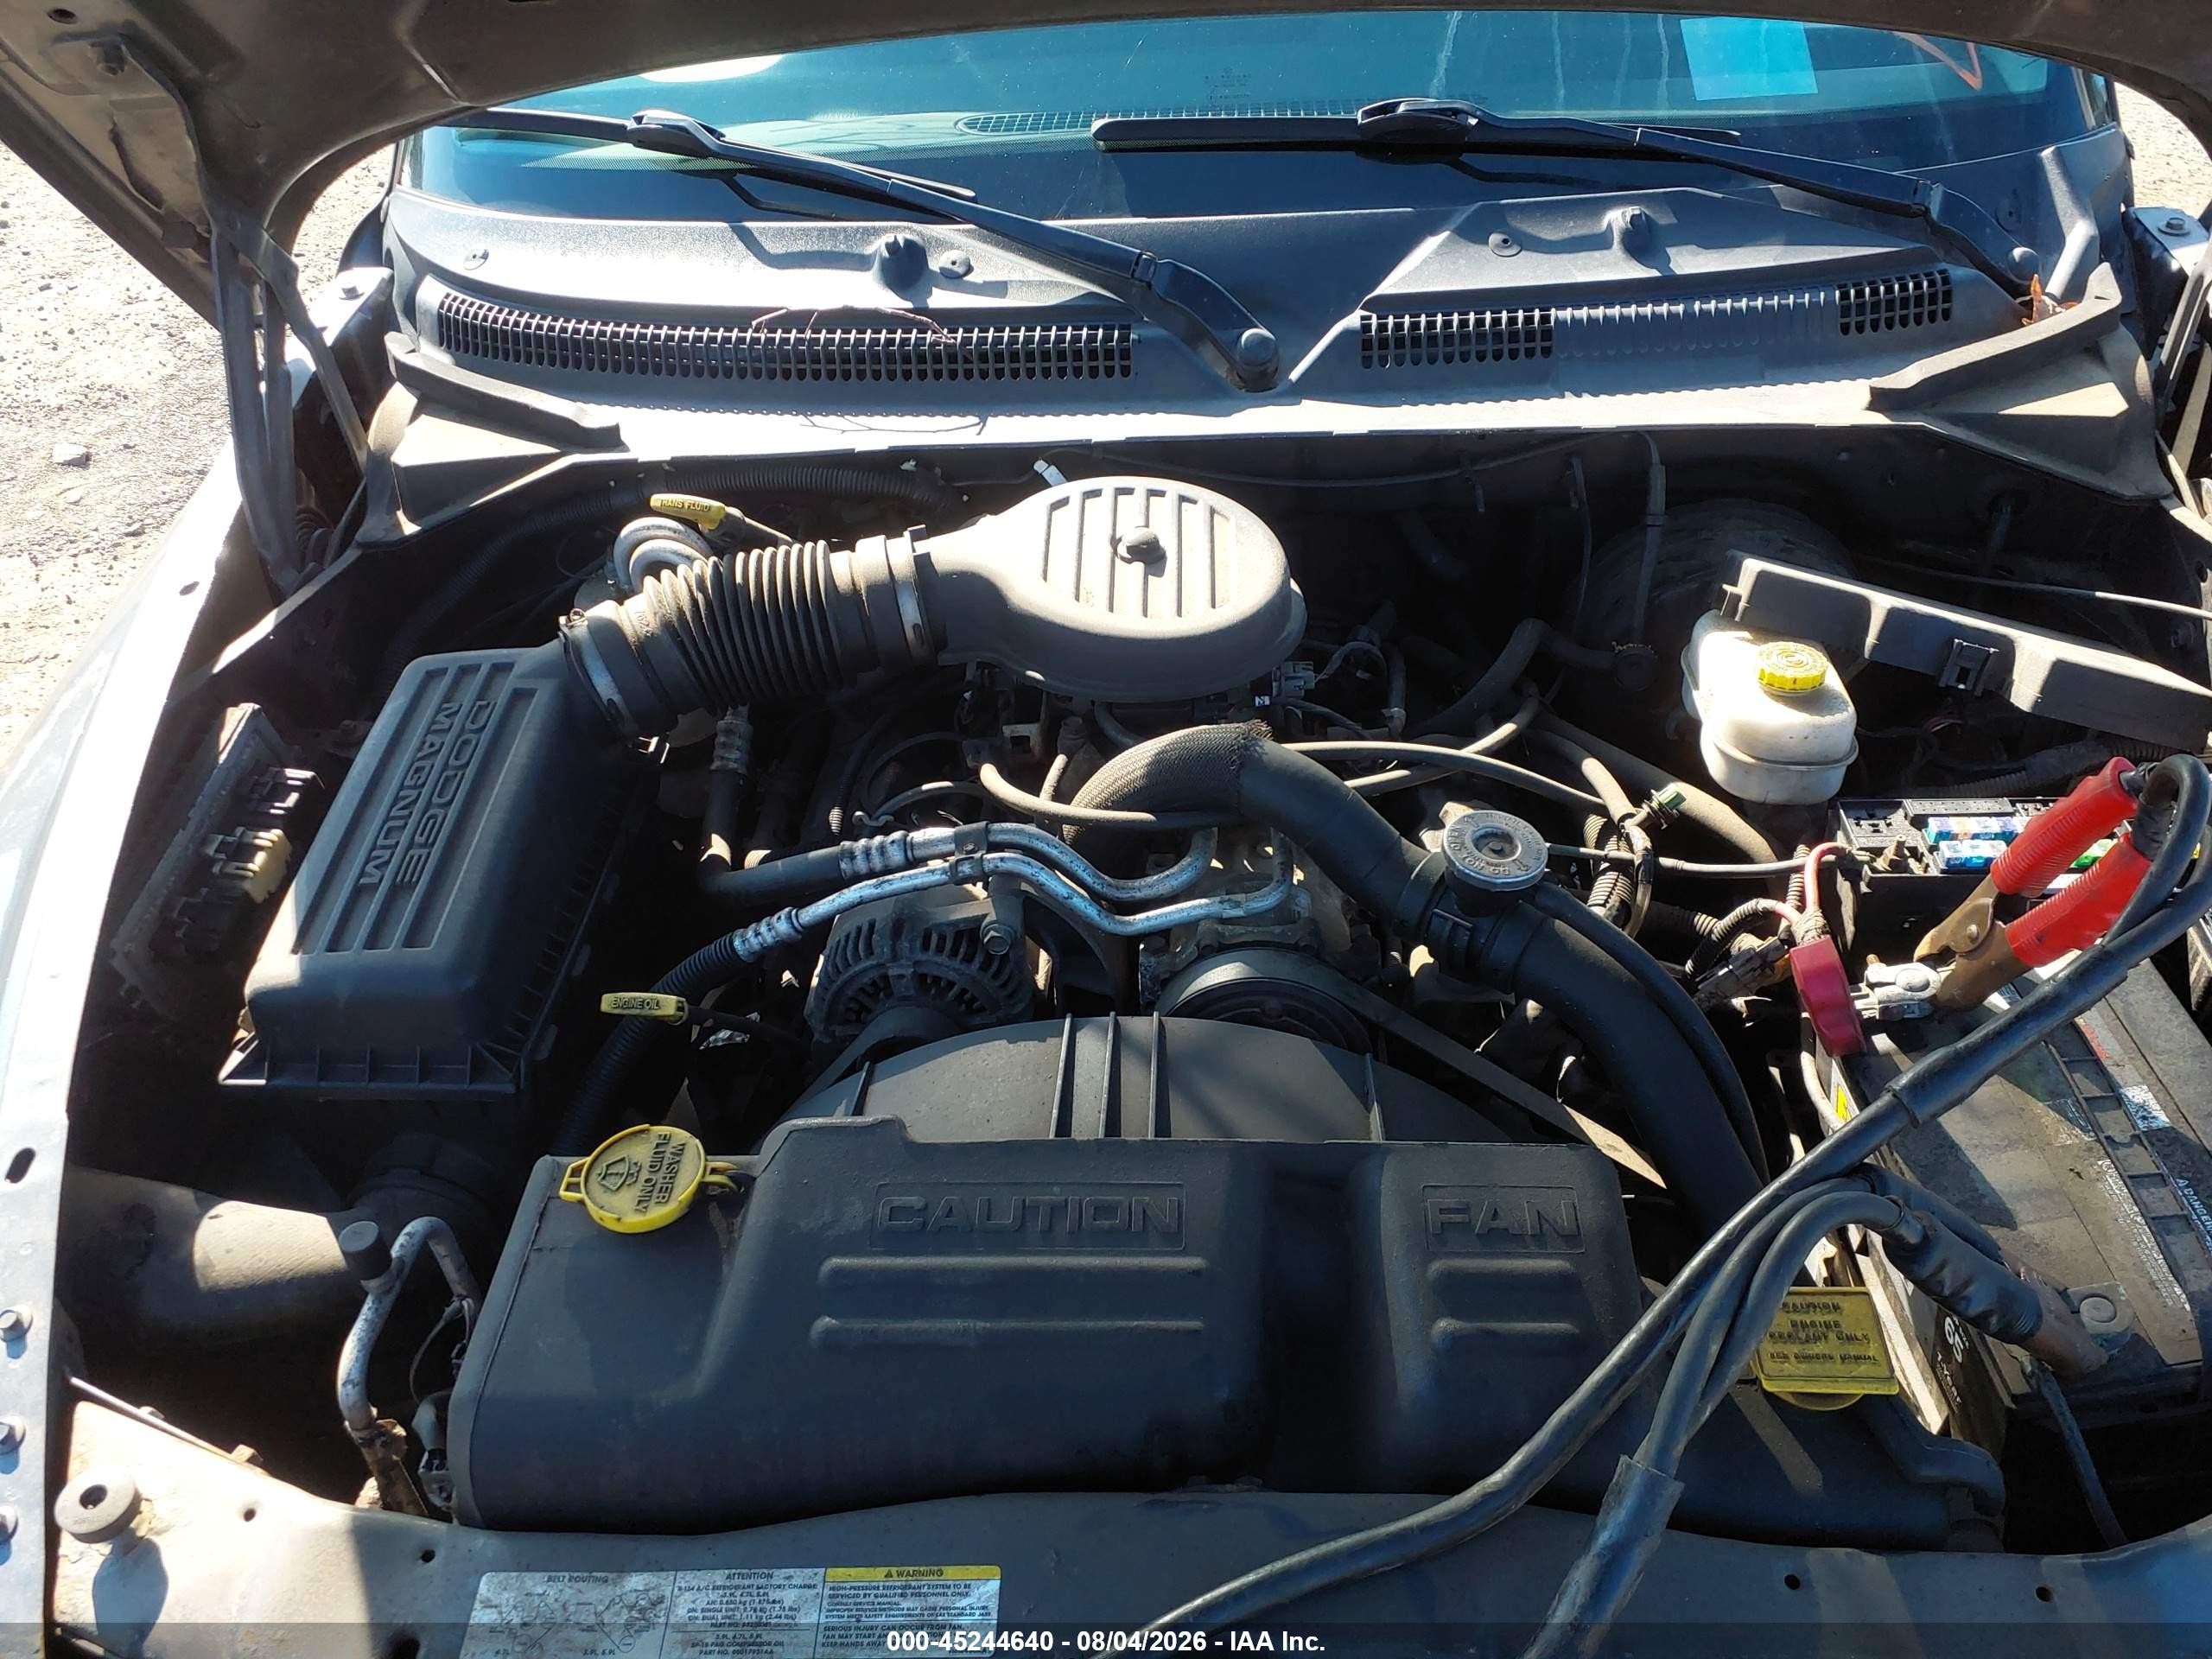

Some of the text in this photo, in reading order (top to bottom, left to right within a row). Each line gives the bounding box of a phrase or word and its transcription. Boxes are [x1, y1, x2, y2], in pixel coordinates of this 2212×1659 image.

[684, 499, 710, 512] FLUID
[359, 702, 462, 886] MAGNUM
[397, 700, 496, 884] DODGE
[611, 996, 660, 1010] ENGINE OIL
[634, 1132, 671, 1214] FLUID ONLY
[655, 1141, 685, 1204] WASHER
[877, 1196, 1180, 1232] CAUTION
[1427, 1198, 1580, 1236] FAN
[1782, 1301, 1842, 1313] CAUTION
[1789, 1319, 1842, 1330] ENGINE
[1835, 1332, 1871, 1344] ONLY
[1944, 1316, 1964, 1363] 65
[1839, 1352, 1879, 1363] MANUAL
[546, 1574, 609, 1583] BELT ROUTING
[896, 1568, 944, 1578] WARNING
